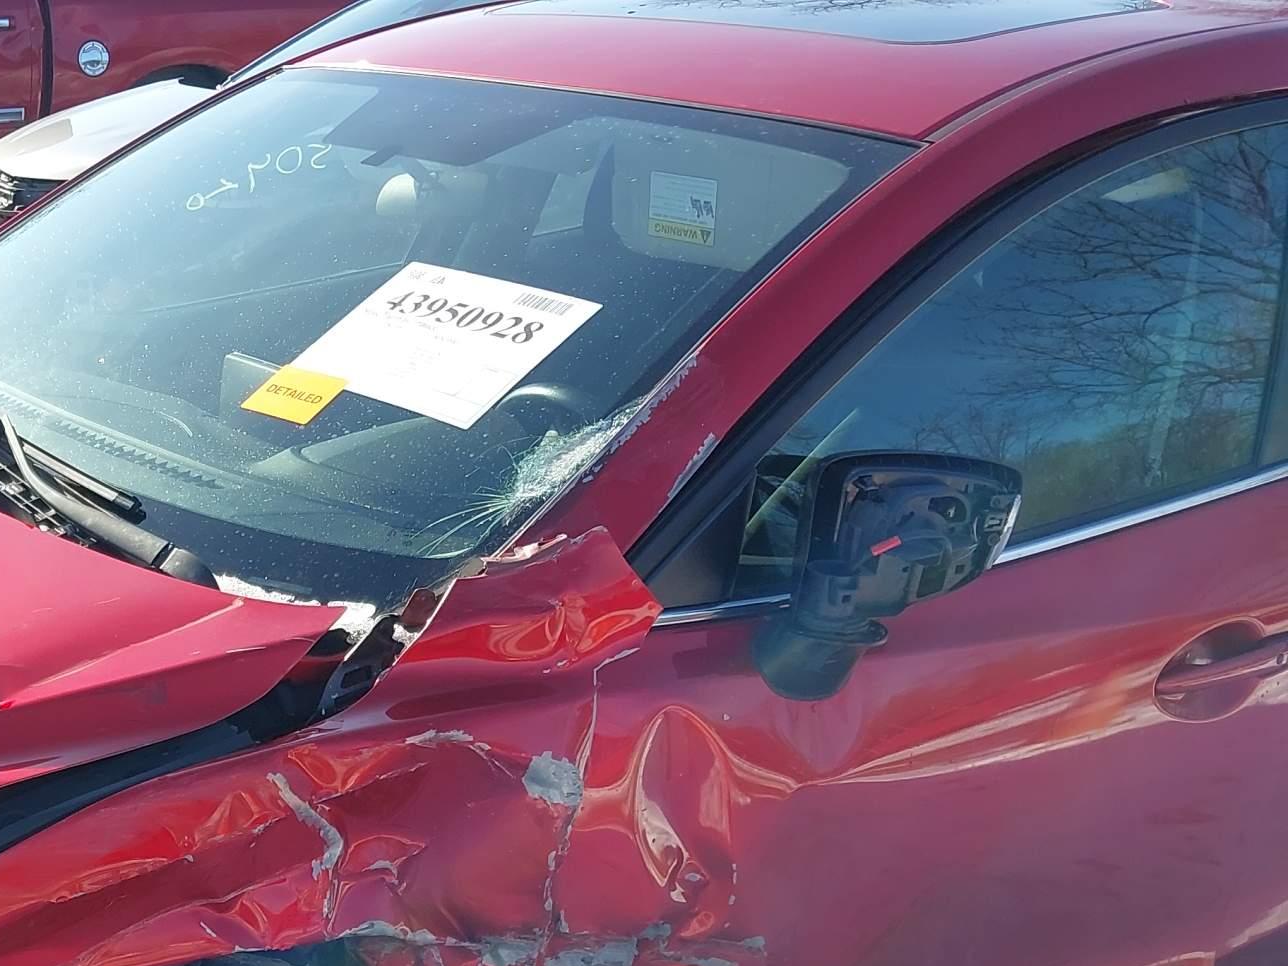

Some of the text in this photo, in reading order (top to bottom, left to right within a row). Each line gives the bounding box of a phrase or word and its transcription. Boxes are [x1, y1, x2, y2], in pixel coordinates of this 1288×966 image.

[654, 223, 698, 239] WARNING
[387, 291, 544, 344] 43950928
[266, 383, 323, 404] DETAILED
